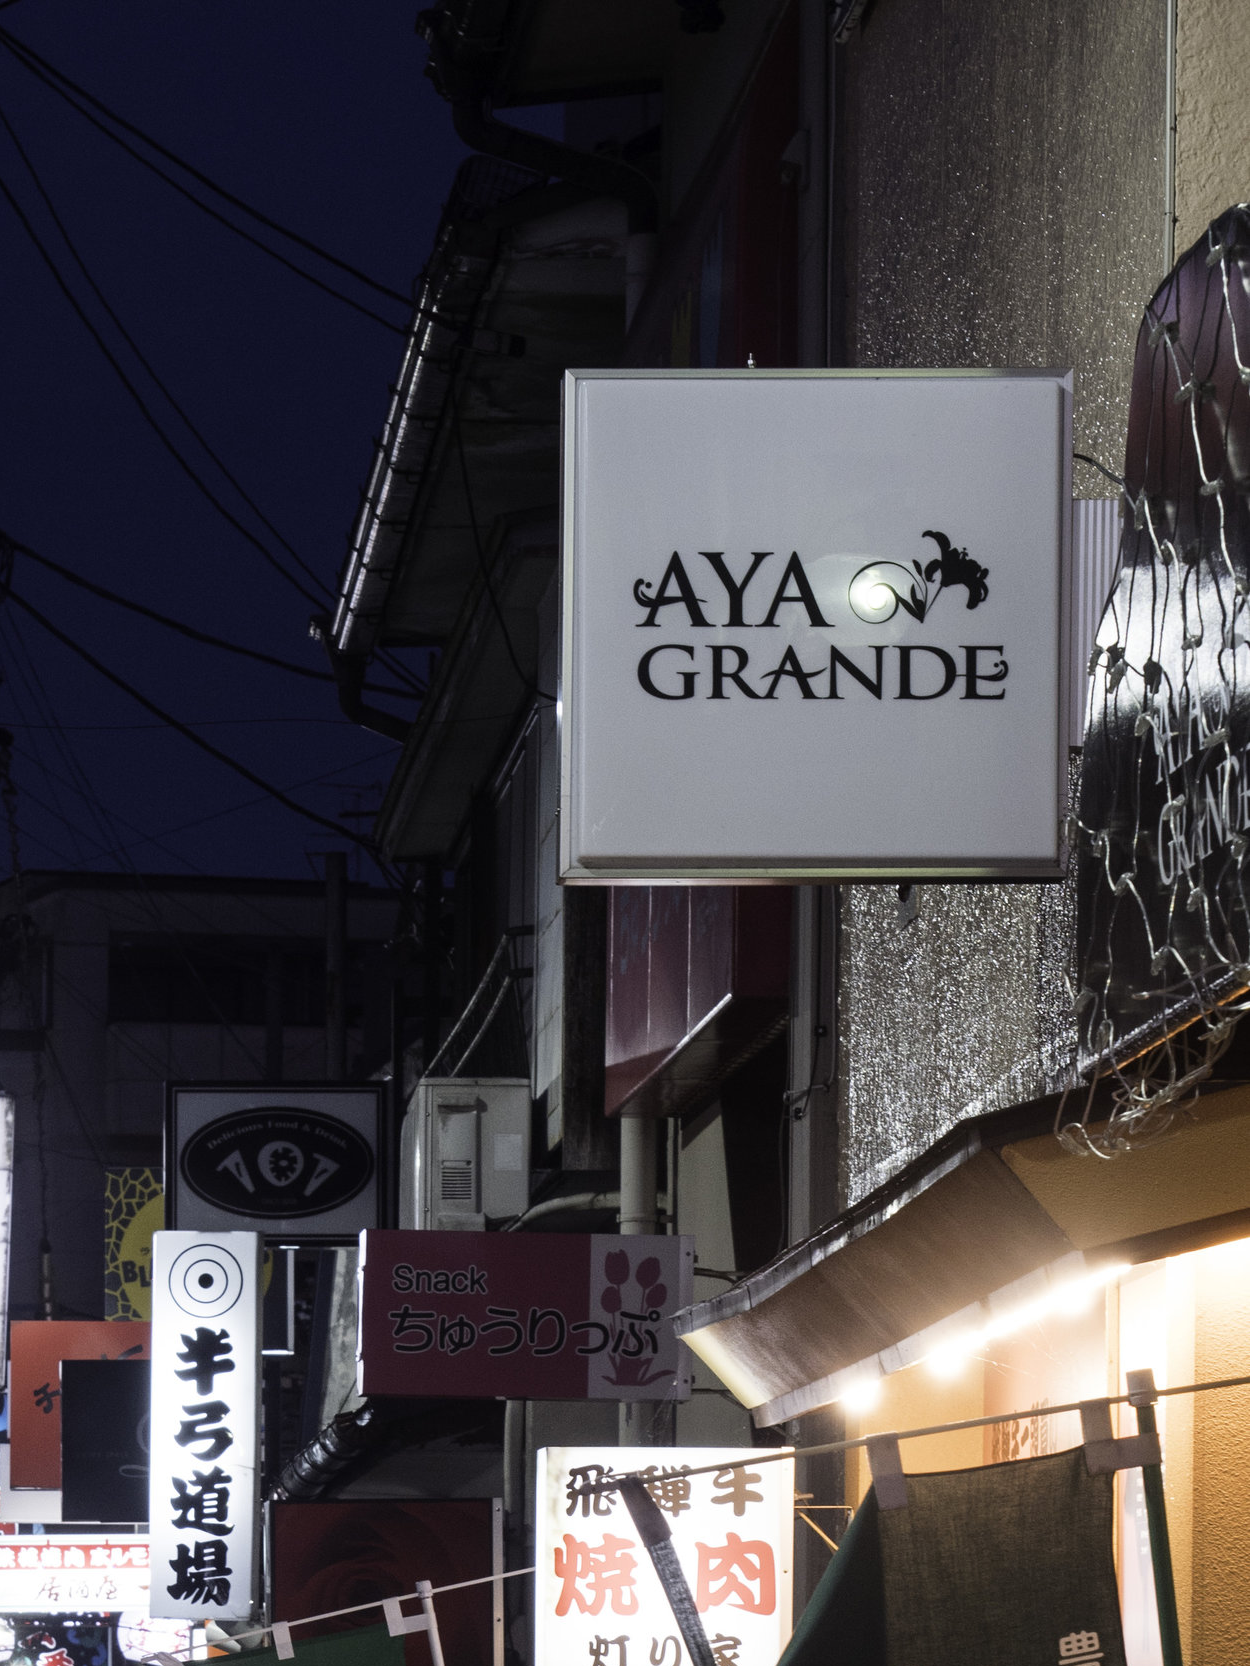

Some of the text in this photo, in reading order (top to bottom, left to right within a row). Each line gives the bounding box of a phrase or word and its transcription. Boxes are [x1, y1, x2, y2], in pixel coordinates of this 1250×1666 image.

[633, 550, 835, 628] AYA
[637, 644, 1009, 701] GRANDE
[207, 1123, 263, 1149] Delicious
[267, 1119, 298, 1129] Food
[315, 1126, 348, 1149] Drink
[392, 1264, 487, 1295] Snack
[388, 1305, 660, 1357] ちゅうりっぷ
[166, 1327, 235, 1607] 半弓道場
[554, 1532, 776, 1617] 焼肉
